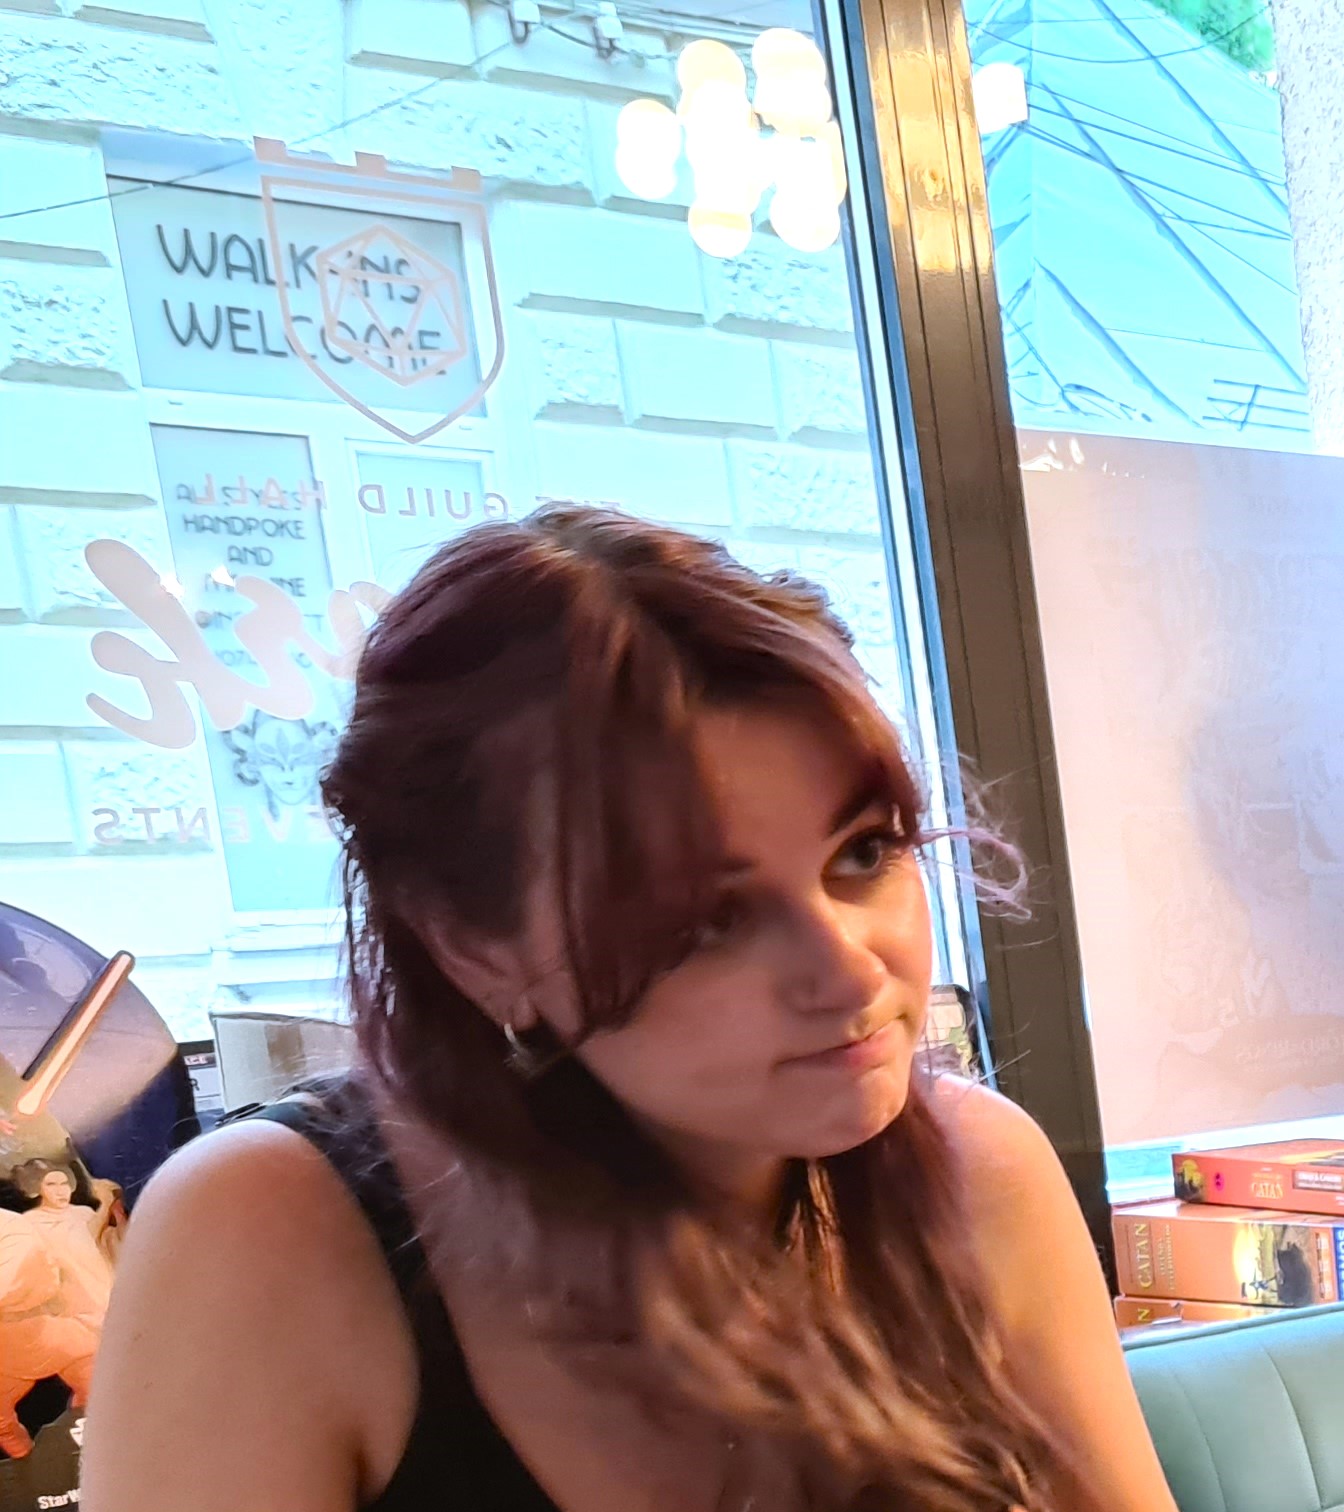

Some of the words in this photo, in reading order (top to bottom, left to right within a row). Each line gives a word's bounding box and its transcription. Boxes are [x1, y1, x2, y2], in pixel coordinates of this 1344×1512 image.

[162, 297, 447, 376] WELCOME
[183, 514, 306, 541] HANDPOKE
[227, 545, 274, 567] AND
[1251, 1182, 1285, 1200] CATAN
[1134, 1222, 1155, 1289] CATAN
